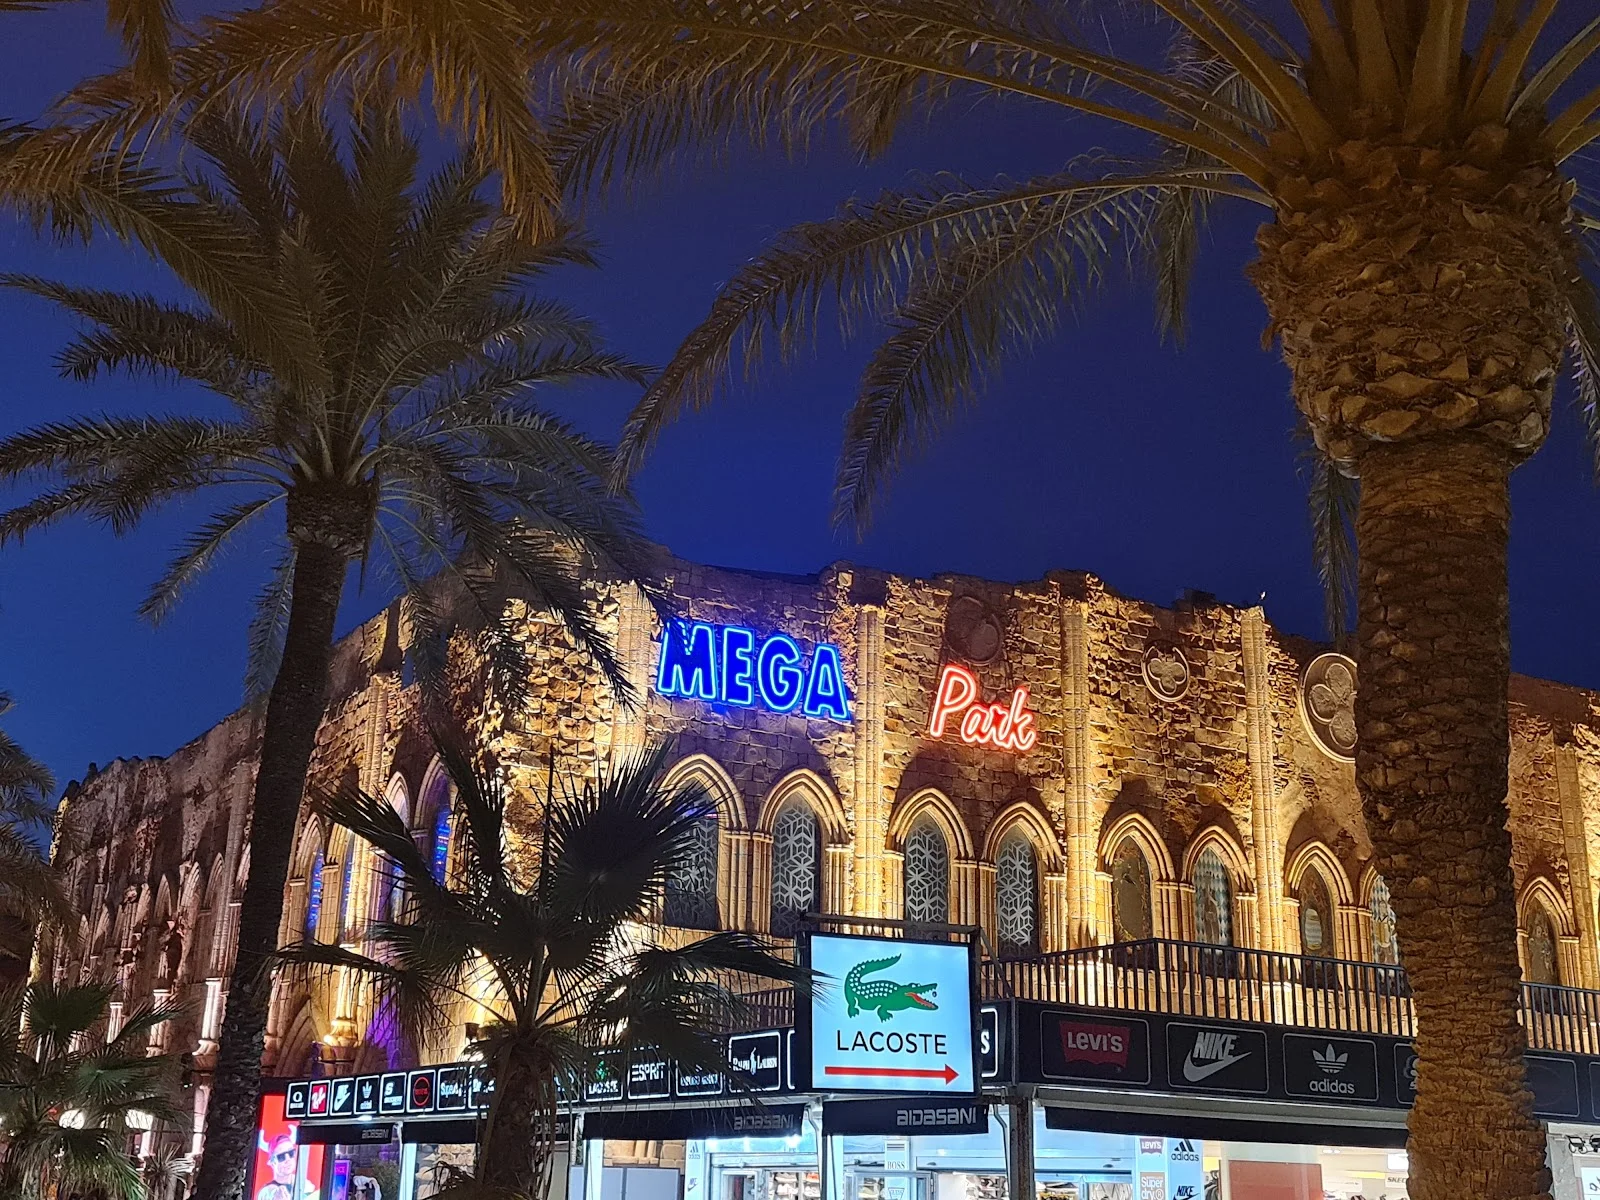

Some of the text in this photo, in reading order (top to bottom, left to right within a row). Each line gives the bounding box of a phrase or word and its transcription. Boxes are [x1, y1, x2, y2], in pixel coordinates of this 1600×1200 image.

[656, 620, 1038, 751] MEGA Park
[837, 1030, 947, 1054] LACOSTE
[1192, 1032, 1238, 1059] NIKE
[632, 1062, 666, 1082] ESPRIT
[1309, 1078, 1355, 1094] adidas
[1171, 1153, 1200, 1161] adidas
[887, 1161, 906, 1170] BOSS
[1141, 1176, 1163, 1190] Super
[1176, 1185, 1195, 1197] NIKE
